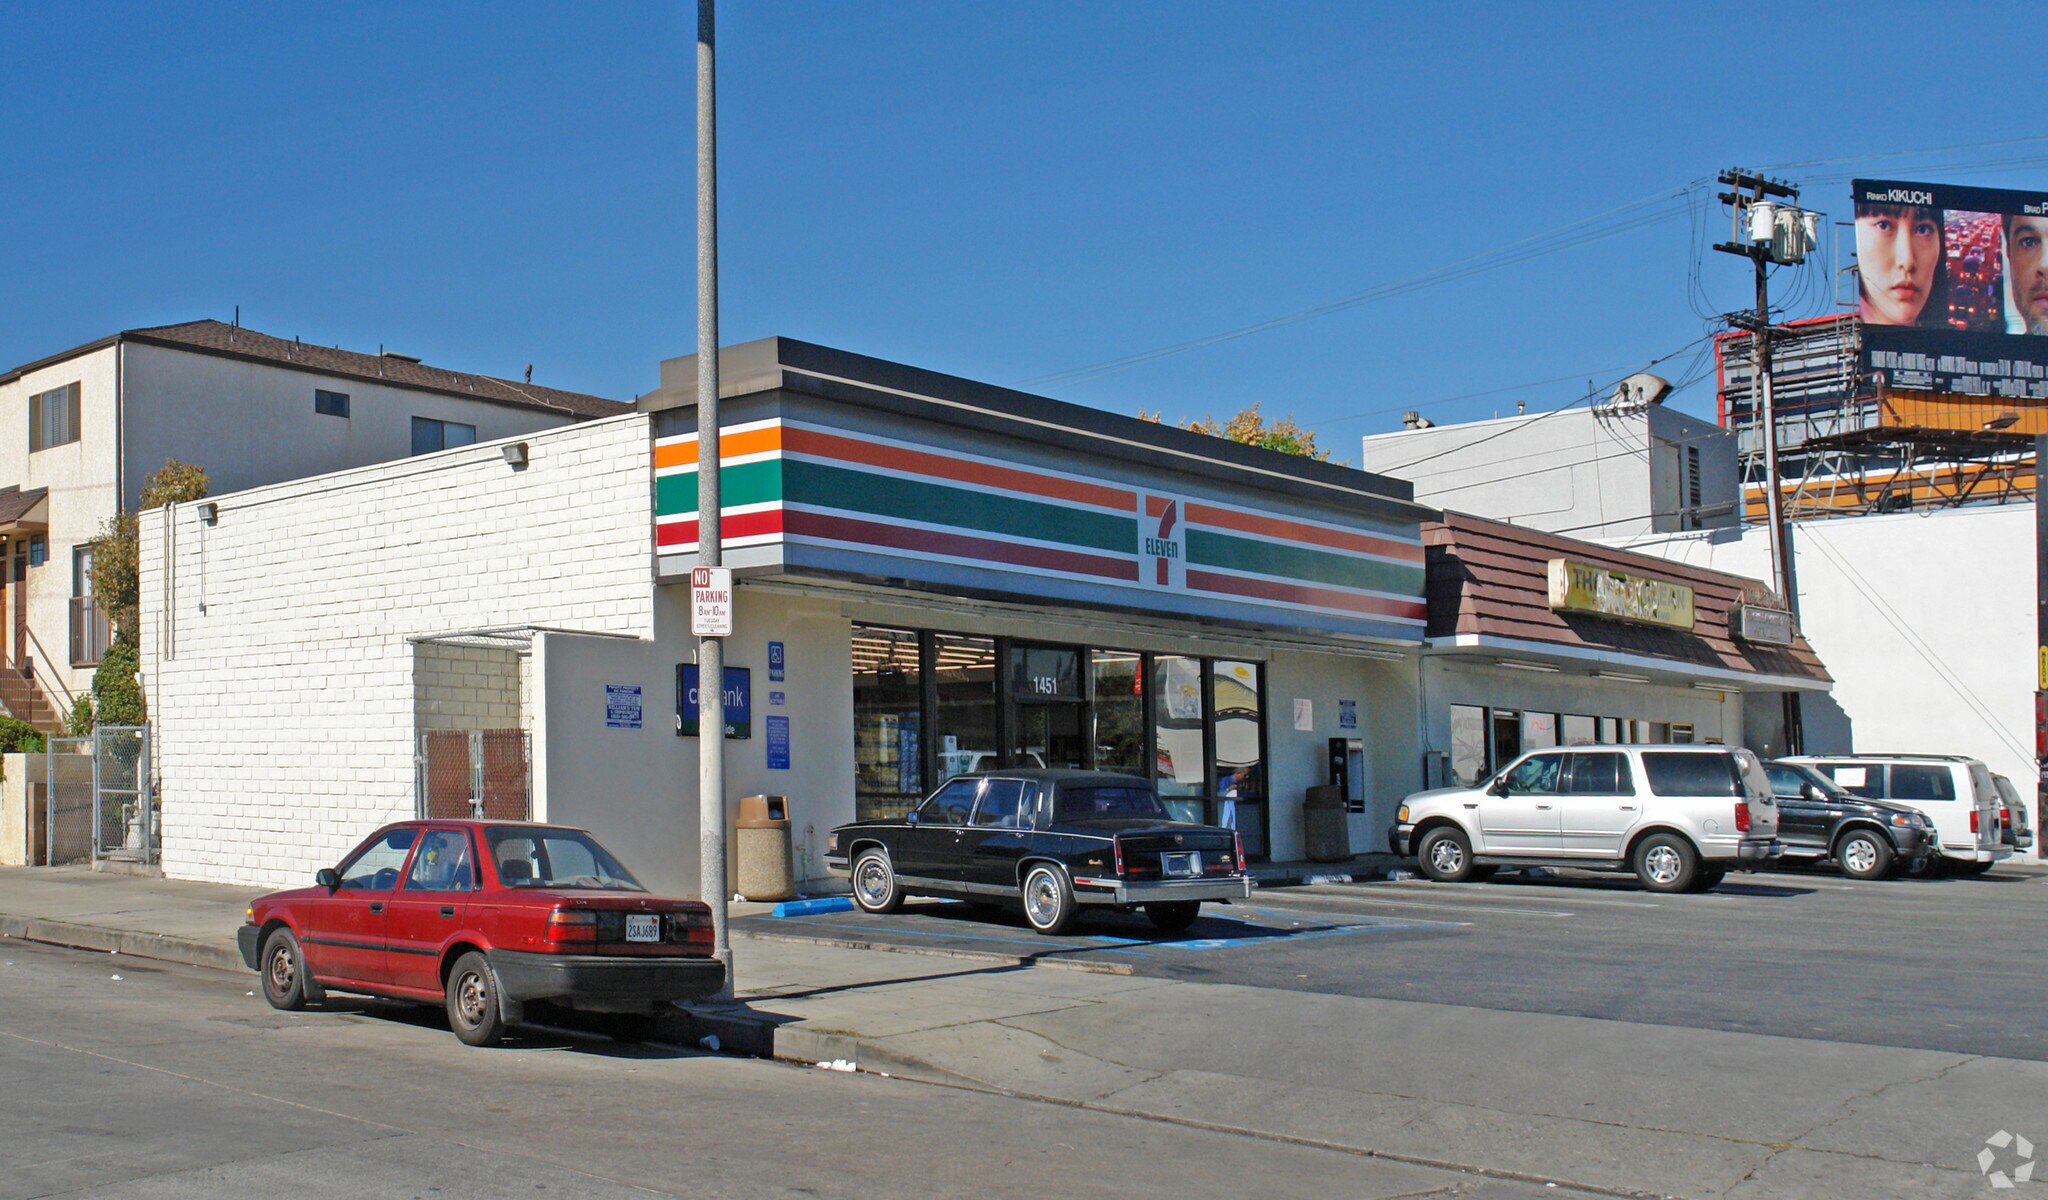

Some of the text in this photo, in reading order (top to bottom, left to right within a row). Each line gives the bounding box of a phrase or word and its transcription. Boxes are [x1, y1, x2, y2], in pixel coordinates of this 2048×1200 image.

[1888, 188, 1933, 205] KIKUCHI
[1156, 500, 1177, 585] 7
[694, 570, 708, 585] NO
[695, 590, 728, 603] PARKING
[1033, 676, 1057, 694] 1451
